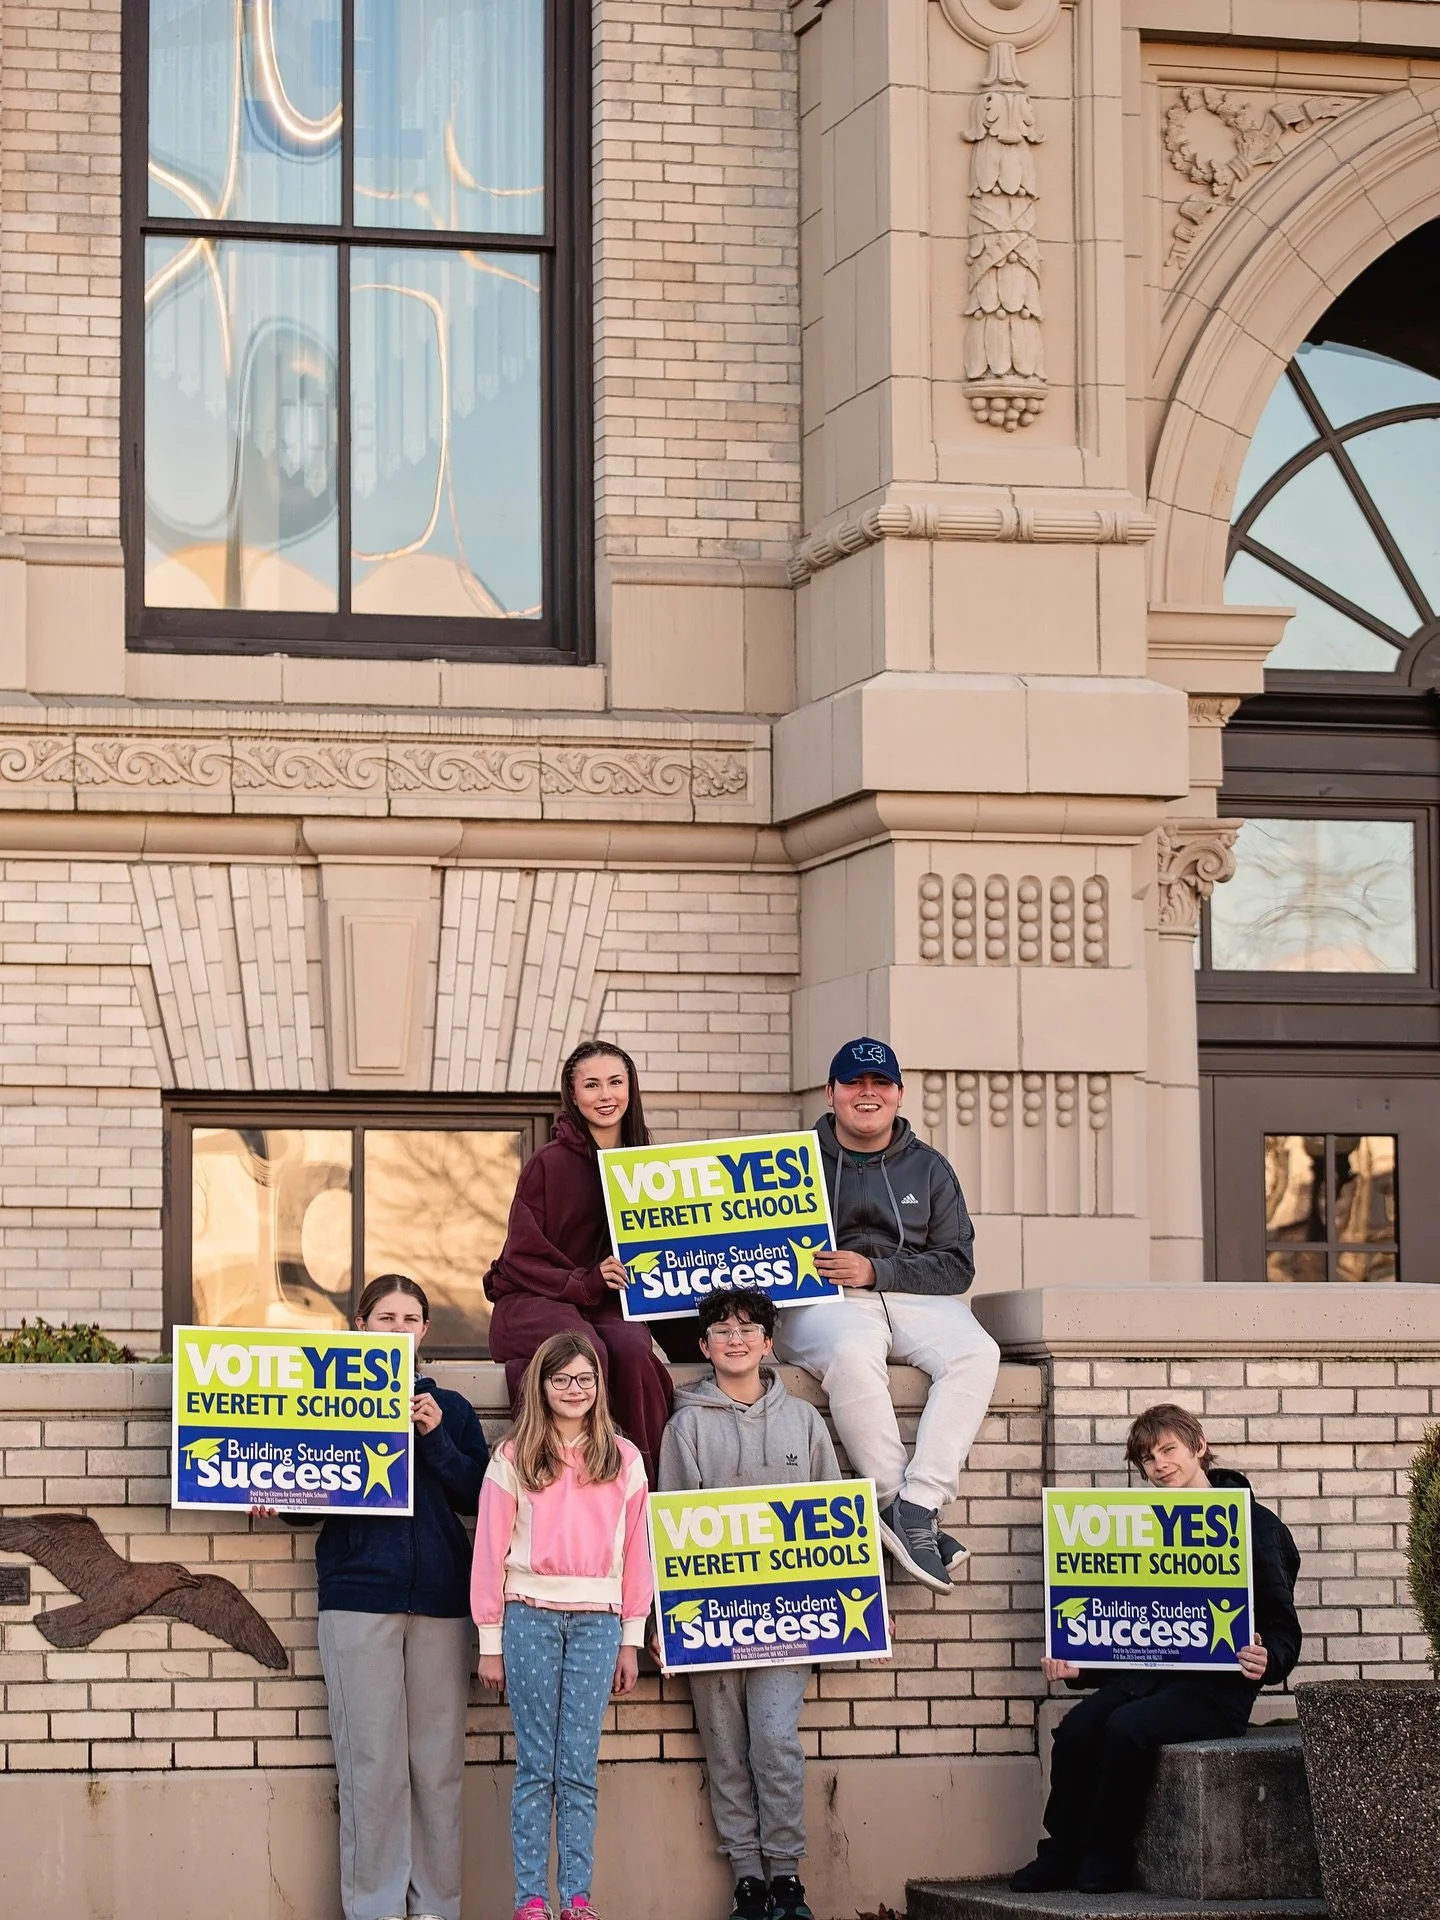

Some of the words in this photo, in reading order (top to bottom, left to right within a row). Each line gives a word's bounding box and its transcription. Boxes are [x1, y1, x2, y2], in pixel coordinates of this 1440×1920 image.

[611, 1156, 724, 1204] VOTE
[717, 1146, 814, 1193] YES!
[621, 1202, 712, 1231] EVERETT
[722, 1192, 817, 1220] SCHOOLS
[664, 1250, 726, 1268] Building
[730, 1244, 789, 1262] Student
[641, 1260, 793, 1299] Success
[184, 1343, 303, 1388] VOTE
[301, 1347, 401, 1392] YES!
[187, 1392, 288, 1415] EVERETT
[297, 1395, 400, 1419] SCHOOLS
[227, 1439, 292, 1464] Building
[298, 1443, 361, 1462] Student
[198, 1456, 361, 1491] Success
[658, 1503, 773, 1550] VOTE
[769, 1494, 868, 1542] YES!
[1053, 1504, 1154, 1547] VOTE
[1151, 1504, 1239, 1548] YES!
[665, 1551, 760, 1578] EVERETT
[771, 1543, 870, 1571] SCHOOLS
[1057, 1553, 1141, 1574] EVERETT
[1150, 1554, 1239, 1575] SCHOOLS
[709, 1600, 770, 1621] Building
[775, 1595, 837, 1613] Student
[1092, 1598, 1147, 1622] Building
[1152, 1601, 1207, 1618] Student
[683, 1612, 840, 1649] Success
[1068, 1614, 1208, 1647] Success
